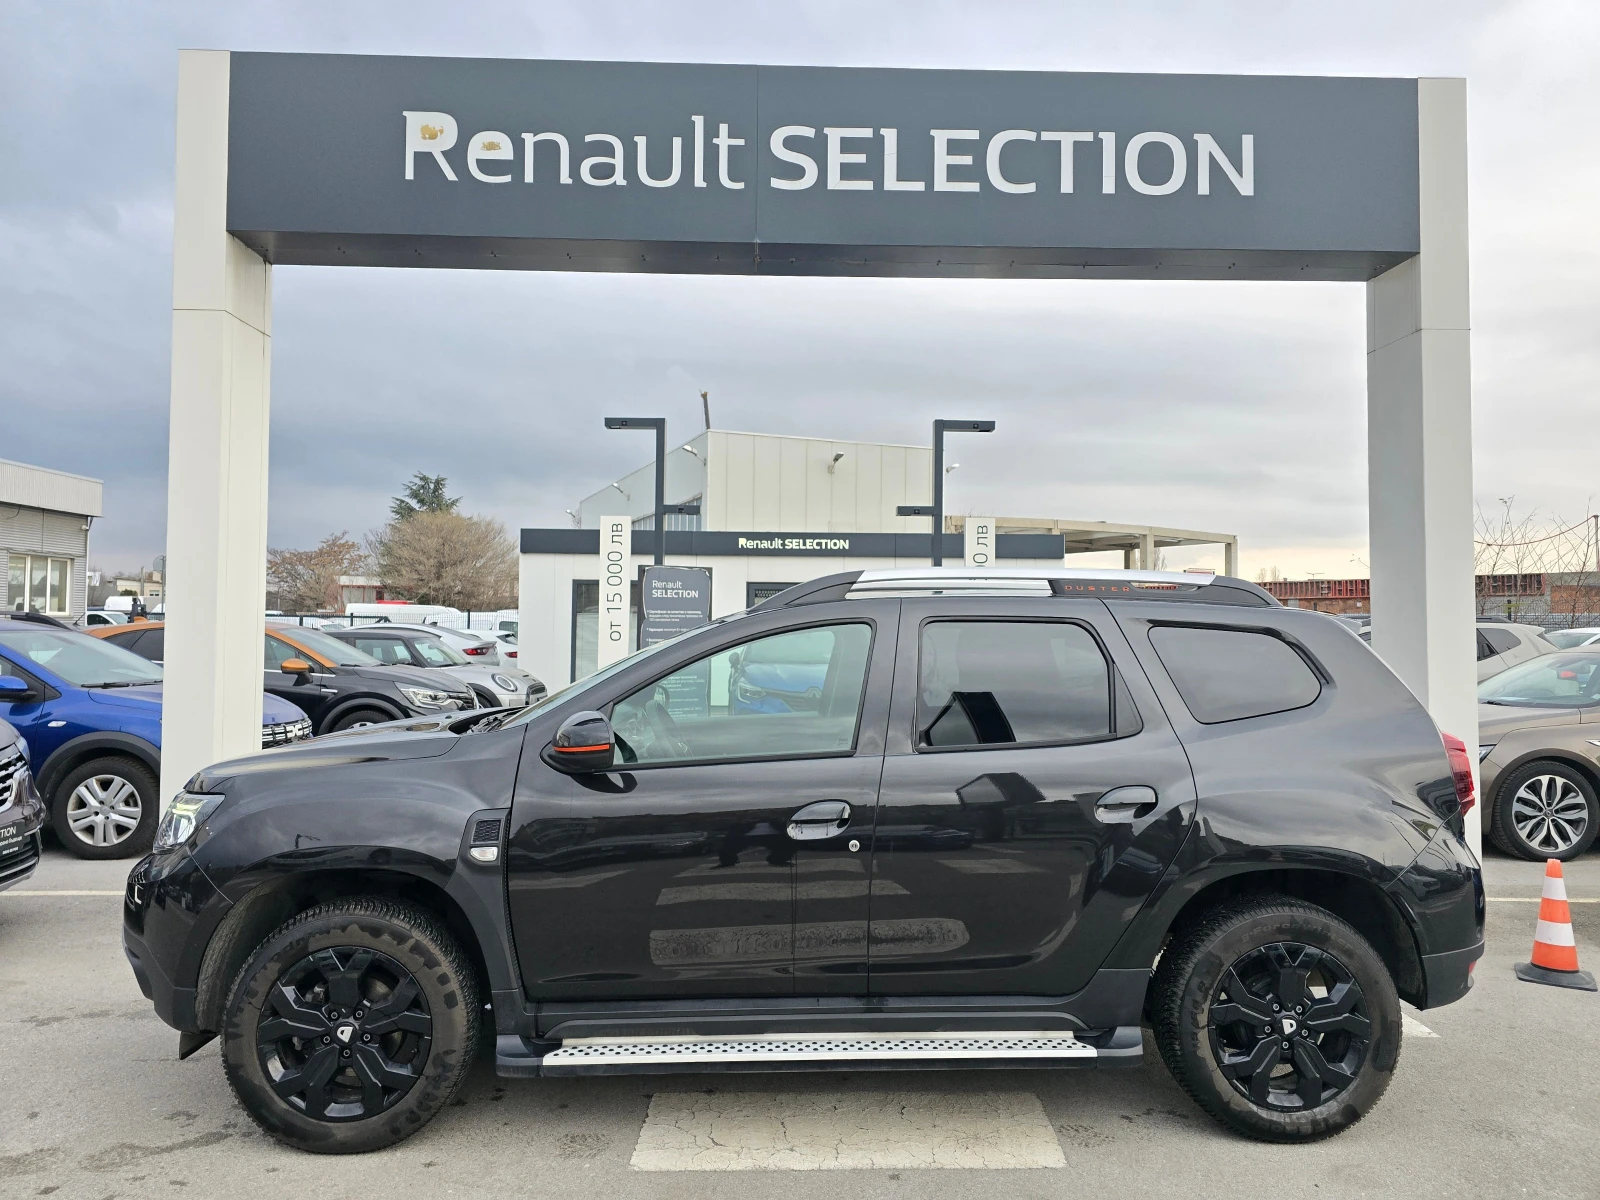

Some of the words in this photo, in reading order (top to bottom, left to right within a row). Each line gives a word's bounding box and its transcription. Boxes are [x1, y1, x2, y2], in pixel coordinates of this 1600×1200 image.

[402, 110, 746, 190] Renault
[769, 125, 1254, 197] SELECTION
[611, 523, 623, 546] лв
[738, 537, 784, 550] Renault
[784, 538, 849, 550] SELECTION
[977, 525, 989, 548] лв
[606, 551, 623, 587] 000
[651, 589, 699, 599] SELECTION
[652, 580, 683, 589] Renault
[1064, 584, 1131, 593] DUSTER
[606, 592, 623, 613] 15
[609, 621, 622, 642] от
